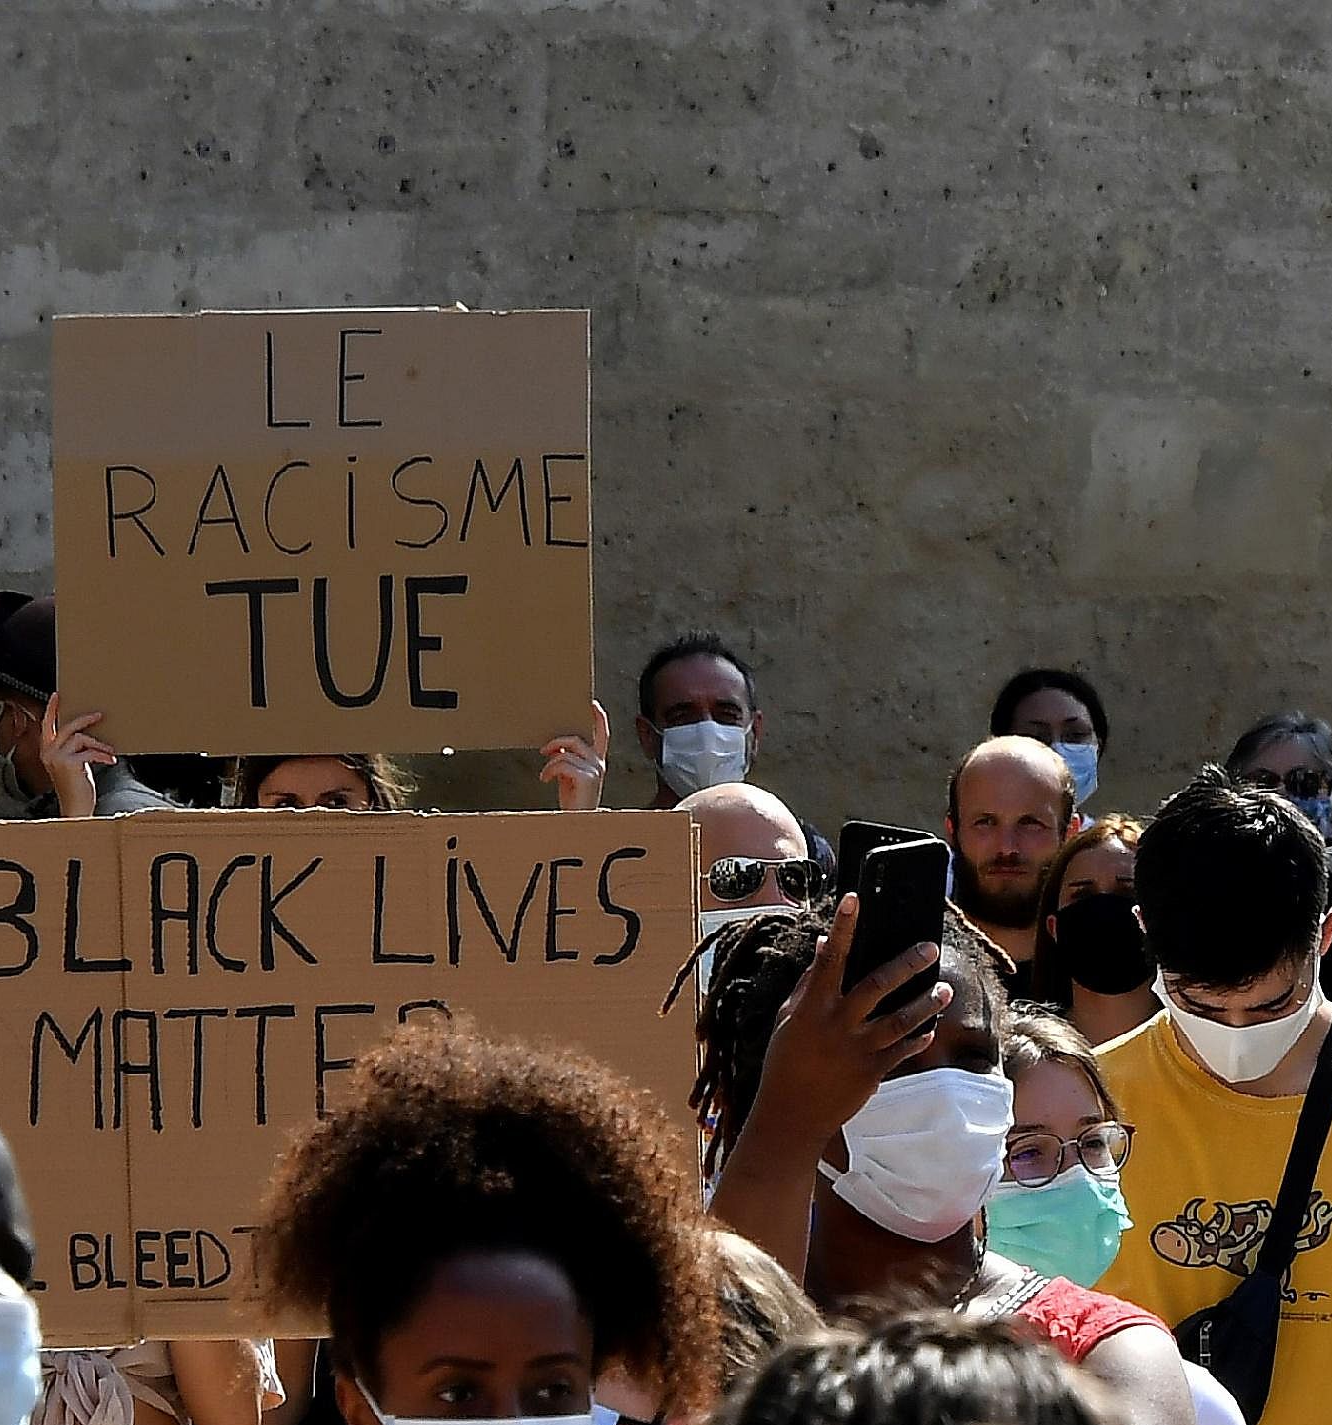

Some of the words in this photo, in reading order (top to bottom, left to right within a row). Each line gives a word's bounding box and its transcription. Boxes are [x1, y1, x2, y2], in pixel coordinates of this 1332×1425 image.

[264, 327, 384, 430] LE
[205, 573, 470, 711] TUE
[28, 1000, 453, 1134] MATTE
[69, 1230, 232, 1290] BLEED
